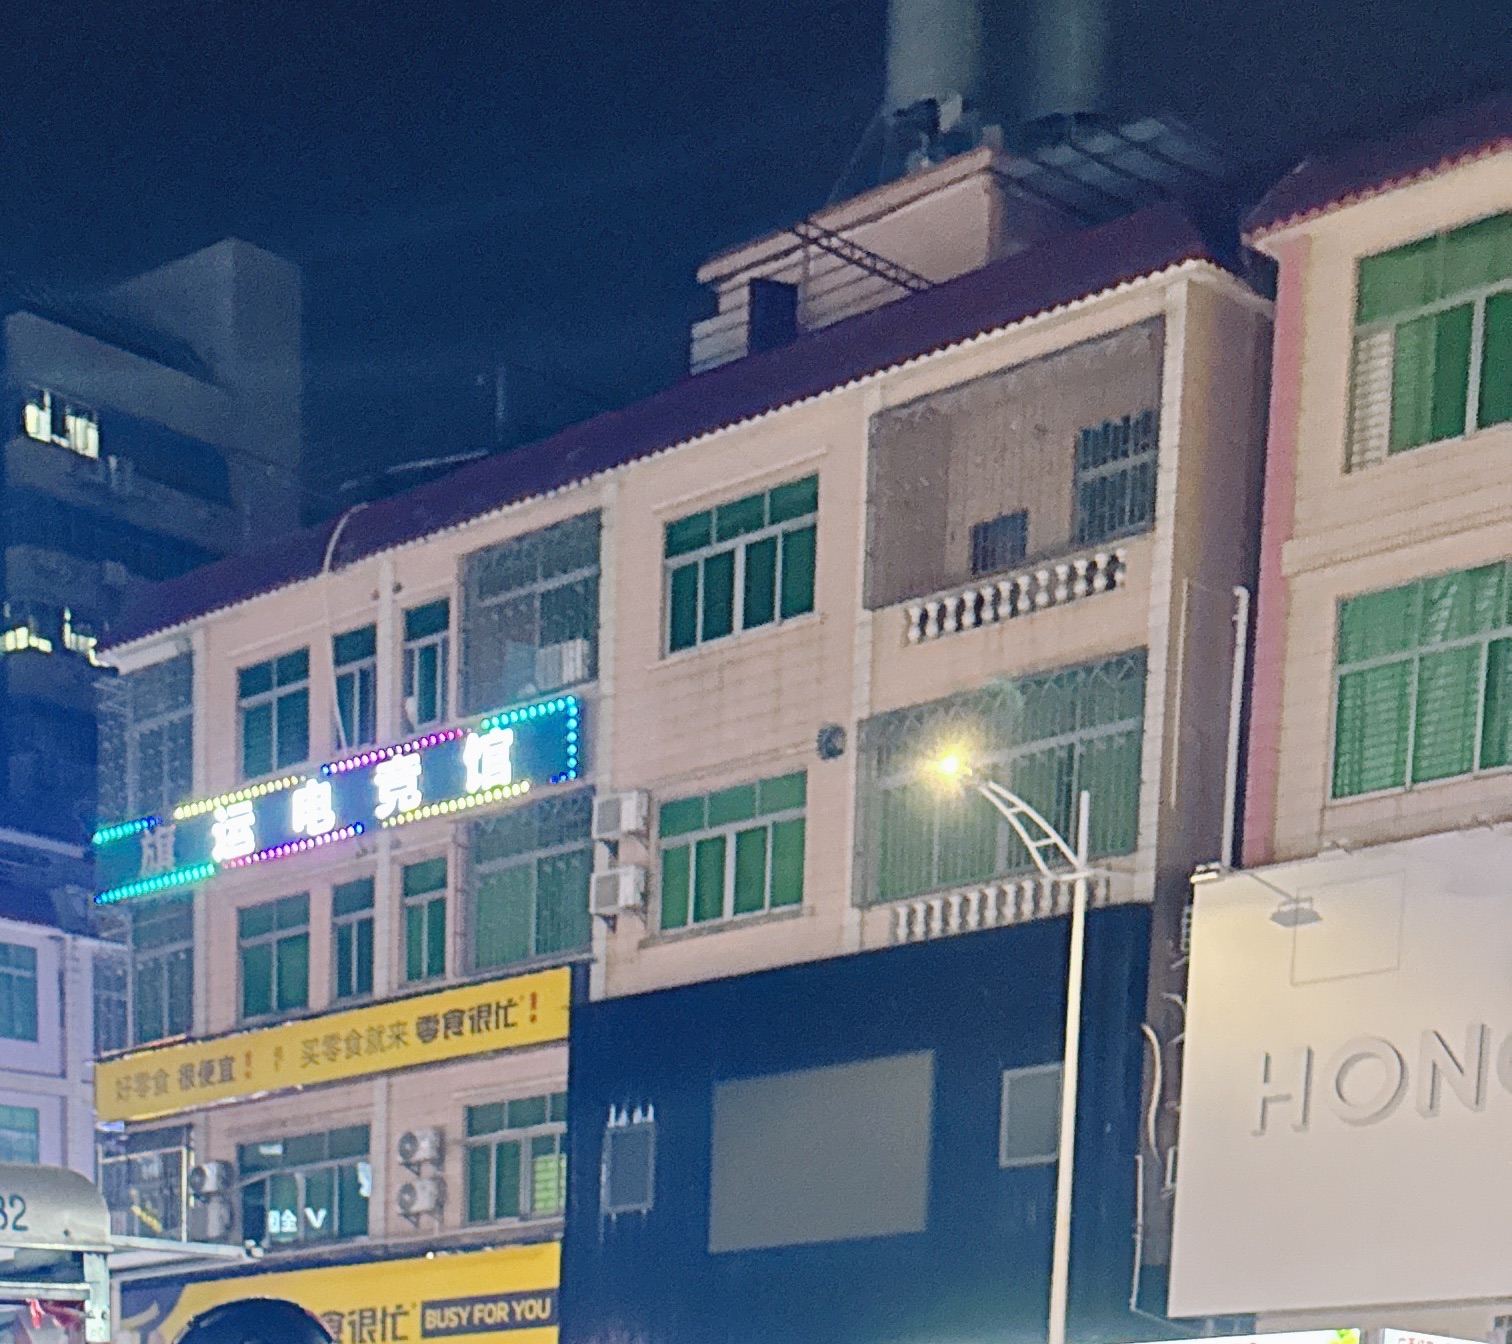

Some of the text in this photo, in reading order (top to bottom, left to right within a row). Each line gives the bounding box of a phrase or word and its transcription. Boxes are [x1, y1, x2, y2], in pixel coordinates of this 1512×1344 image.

[1252, 1023, 1512, 1136] HON
[424, 1307, 470, 1330] BUSY
[473, 1301, 509, 1325] FOR
[512, 1297, 551, 1322] YOU
